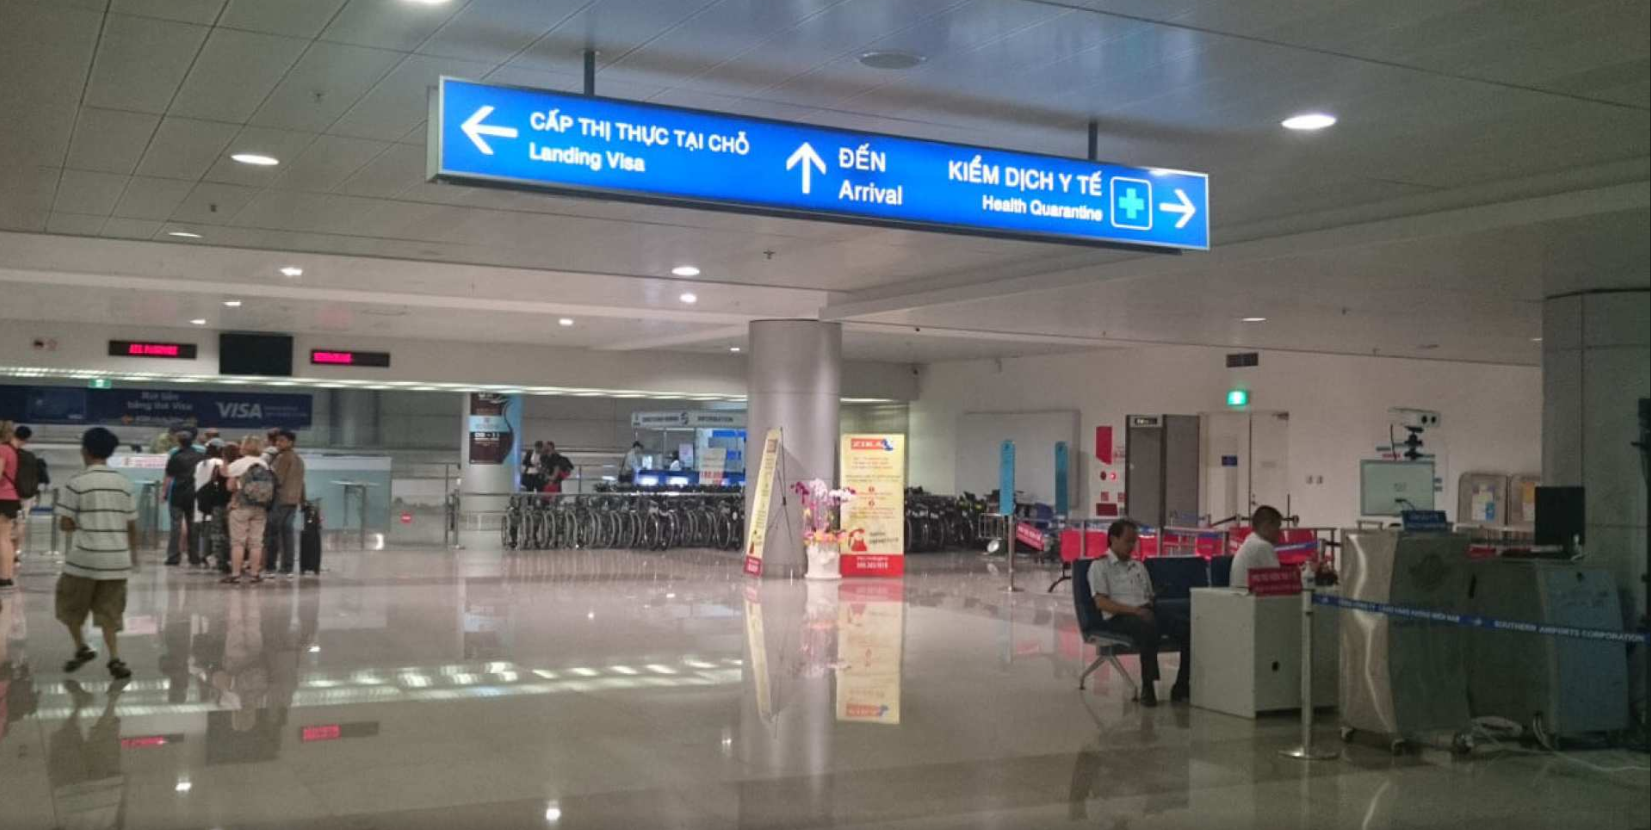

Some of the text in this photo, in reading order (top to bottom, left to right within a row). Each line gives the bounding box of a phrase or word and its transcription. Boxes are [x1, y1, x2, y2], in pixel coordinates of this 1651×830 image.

[530, 108, 750, 155] CẤP THỊ THỰC TẠI CHỖ
[529, 142, 646, 172] Landing Visa
[838, 143, 886, 172] ĐẾN
[948, 154, 1102, 197] KIỂM DỊCH Y TẾ
[838, 179, 903, 205] Arrival
[982, 195, 1104, 222] Health Quarantine
[215, 401, 263, 419] VISA
